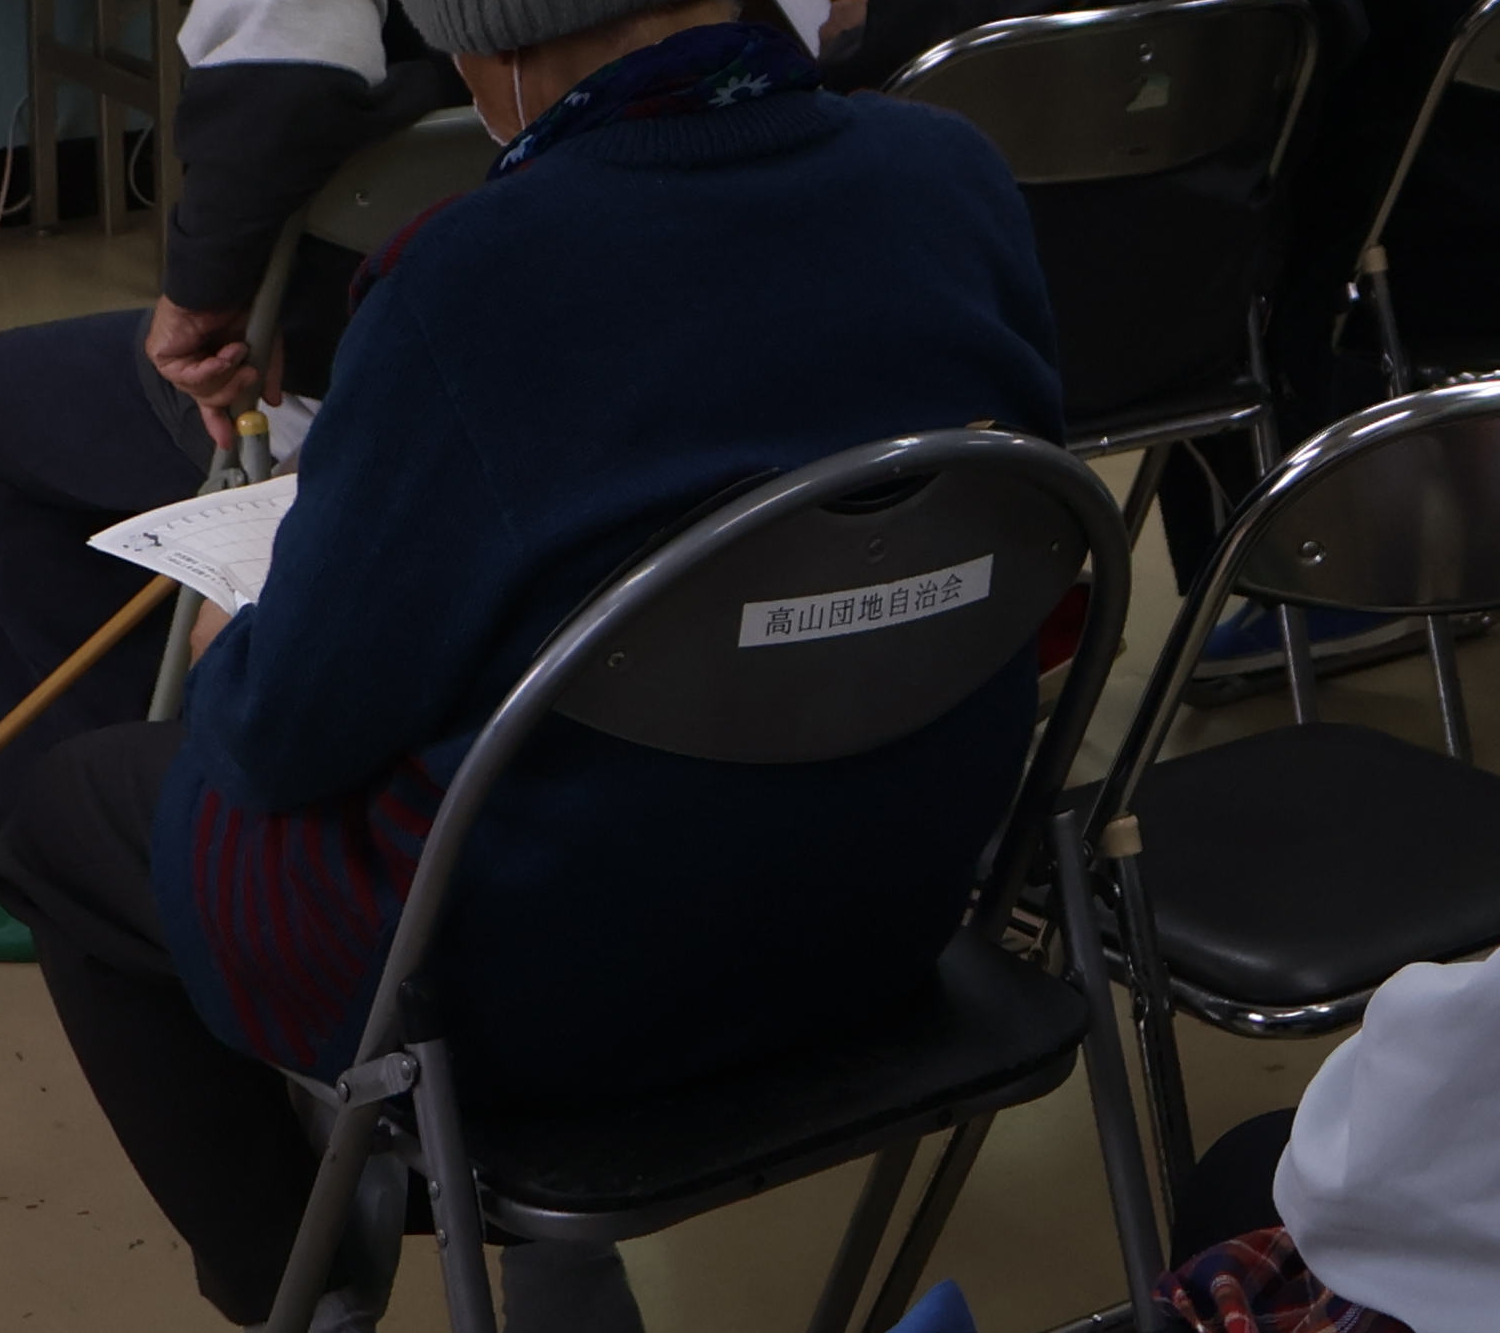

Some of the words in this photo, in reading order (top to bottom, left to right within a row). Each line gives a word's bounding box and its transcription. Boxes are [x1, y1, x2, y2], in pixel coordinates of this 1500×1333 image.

[764, 573, 964, 637] 高山団地自治会
